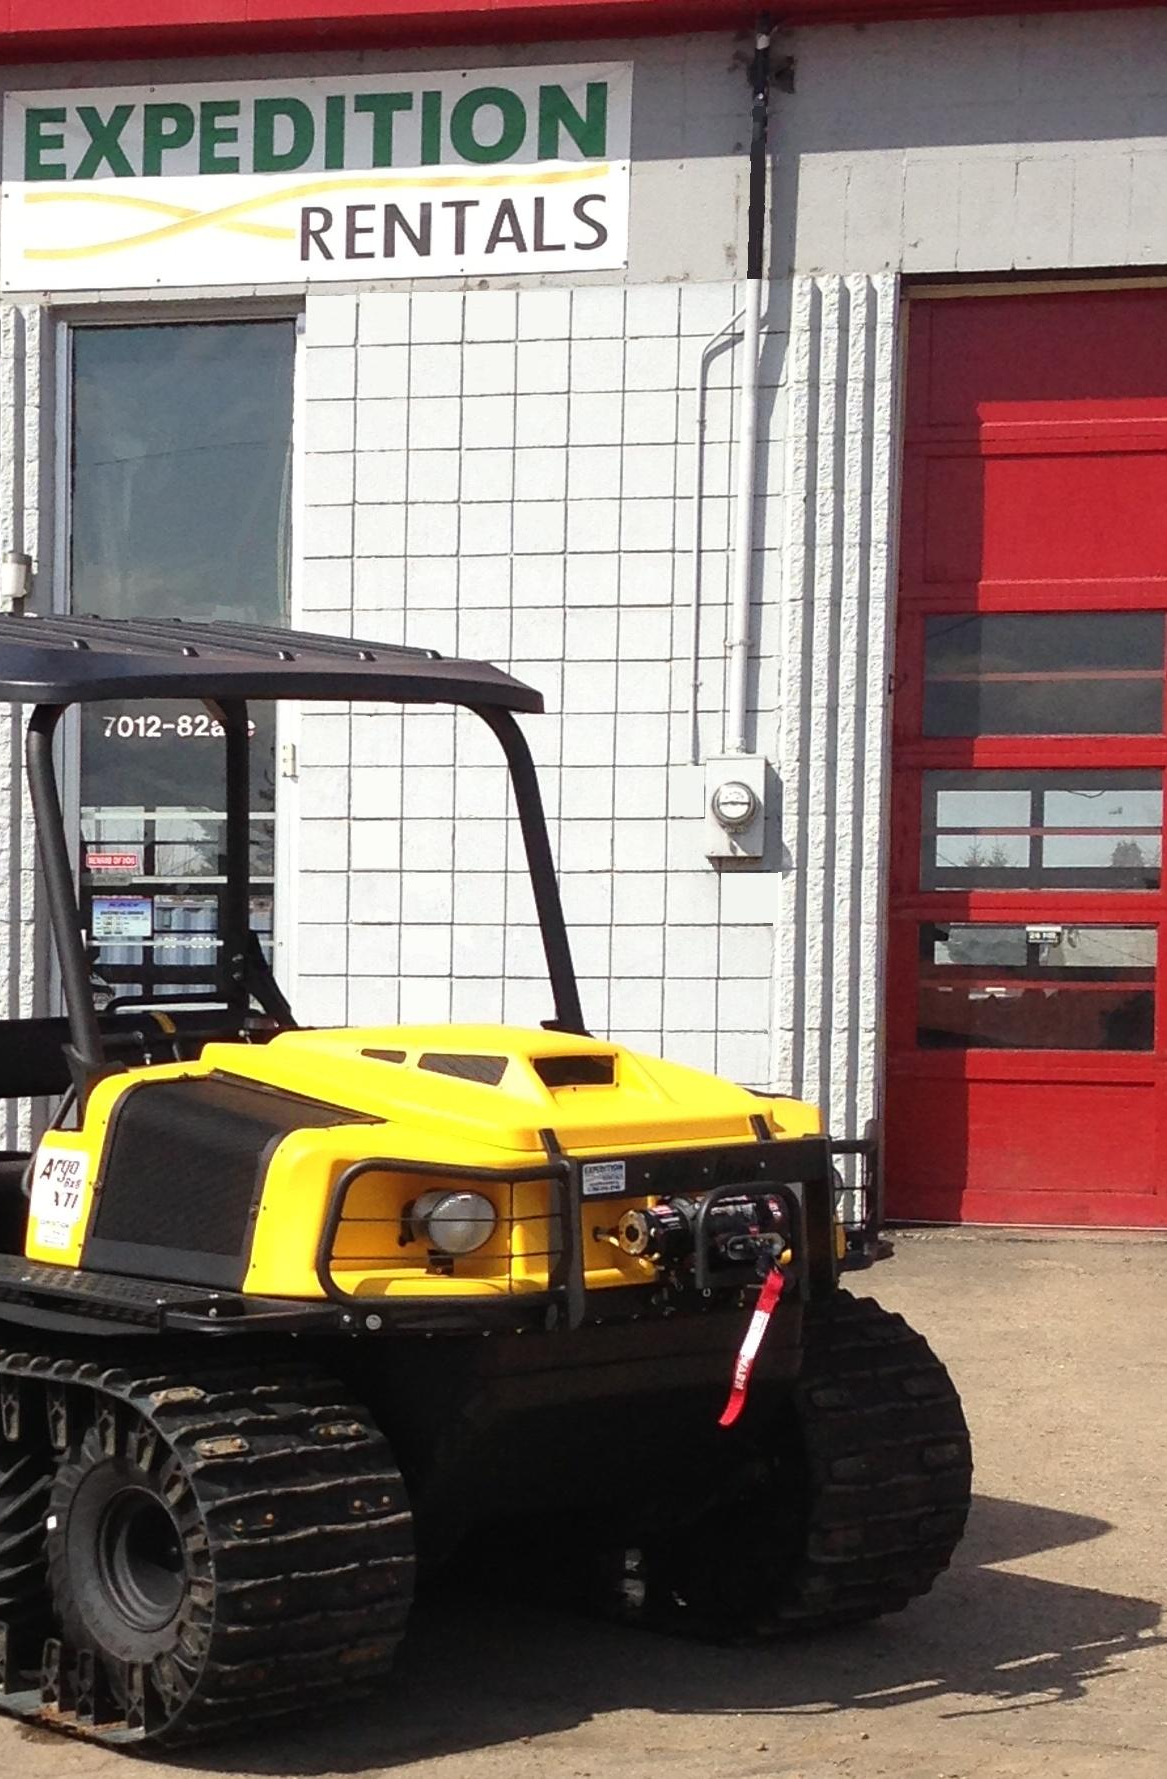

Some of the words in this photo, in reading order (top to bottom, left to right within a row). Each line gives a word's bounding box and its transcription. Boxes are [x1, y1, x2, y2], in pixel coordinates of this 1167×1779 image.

[23, 81, 609, 181] EXPEDITION
[299, 193, 609, 262] RENTALS
[102, 715, 256, 738] 7012-82ae
[39, 1158, 80, 1183] Argo
